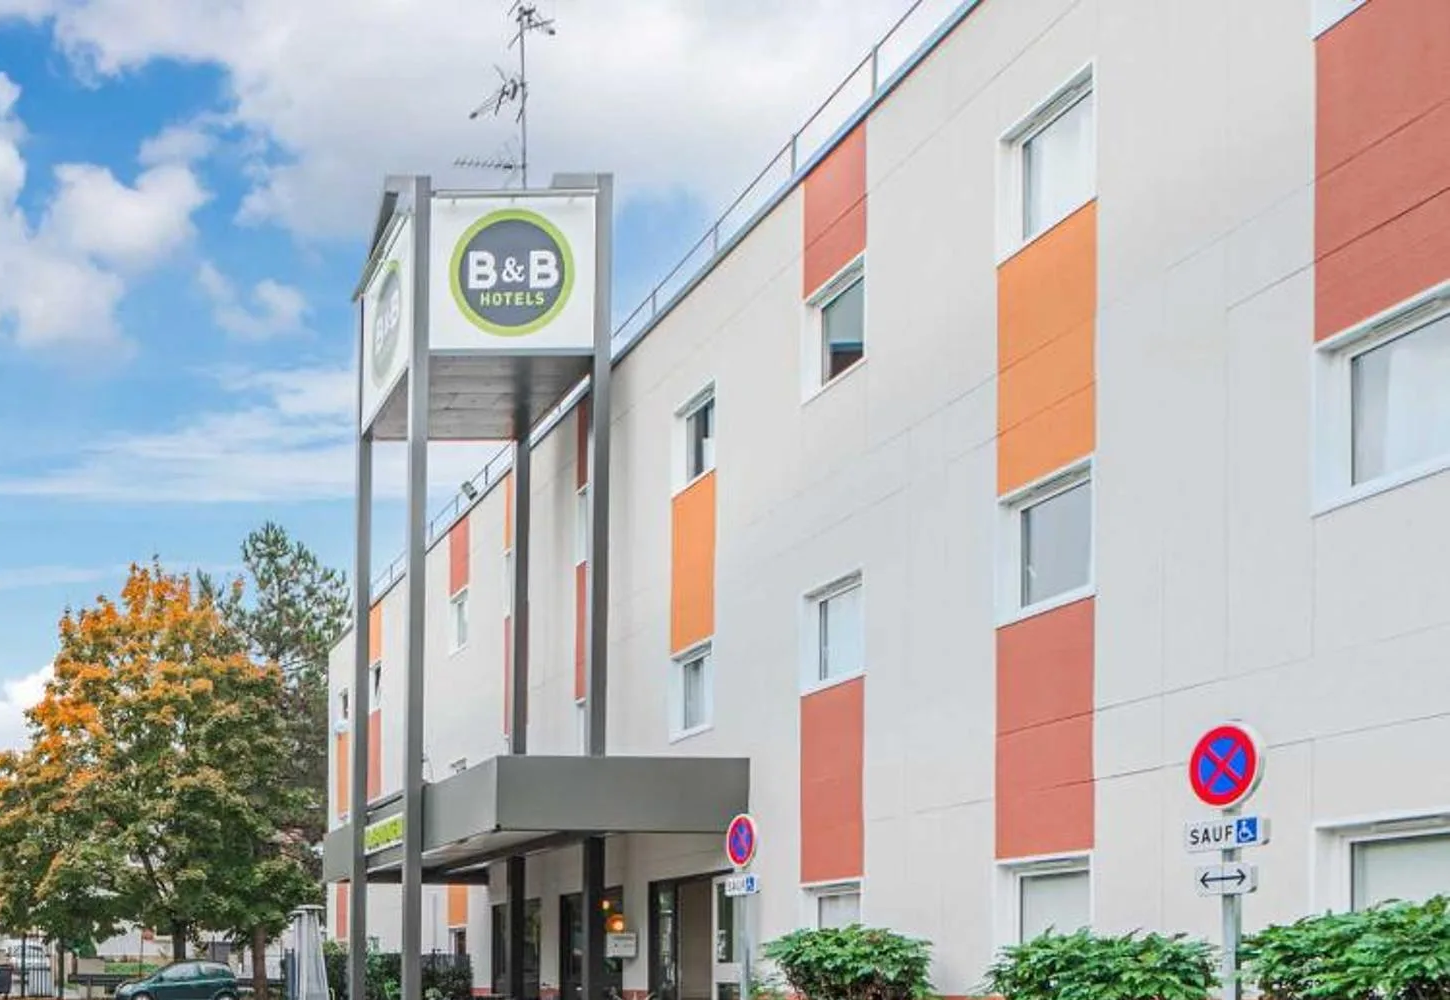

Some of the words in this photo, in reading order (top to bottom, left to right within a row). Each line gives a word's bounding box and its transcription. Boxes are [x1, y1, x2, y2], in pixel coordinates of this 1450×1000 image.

[468, 251, 559, 289] B&B
[480, 292, 544, 306] HOTELS
[1190, 825, 1233, 845] SAUF
